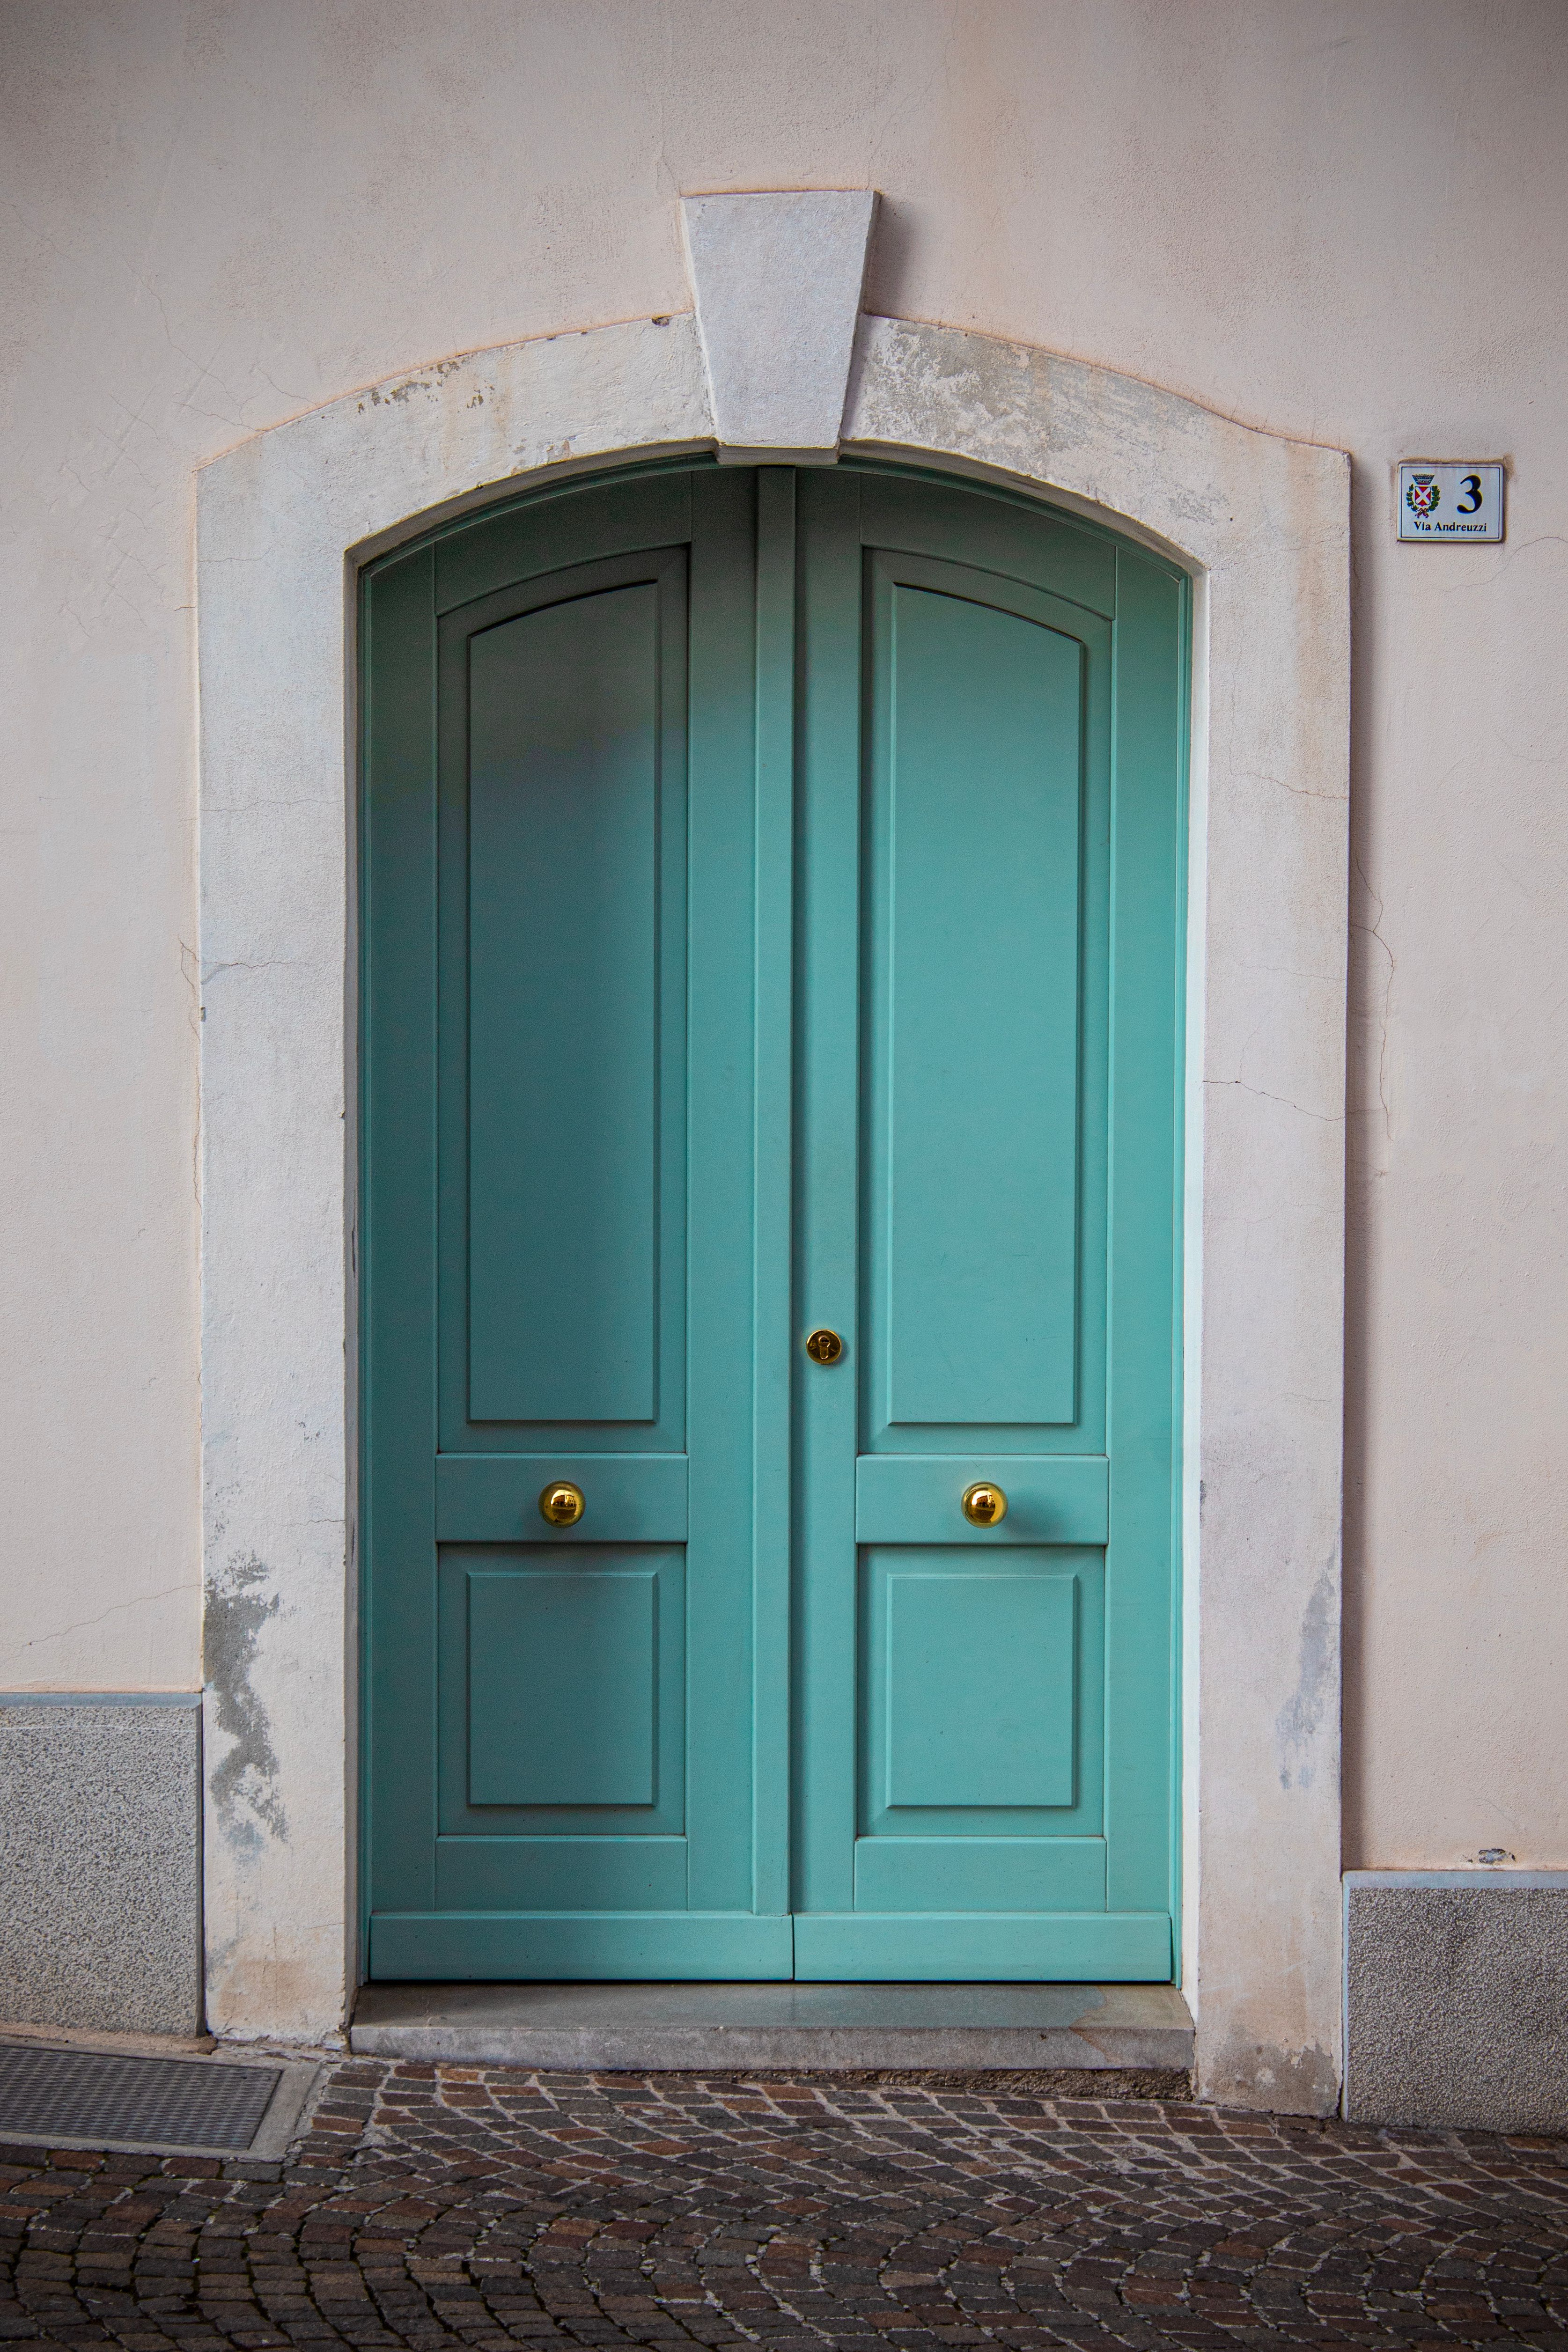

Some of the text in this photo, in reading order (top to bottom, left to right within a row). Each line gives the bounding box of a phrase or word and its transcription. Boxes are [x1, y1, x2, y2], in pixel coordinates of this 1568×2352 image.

[1457, 474, 1483, 514] 3
[1413, 521, 1487, 532] Via Andreuzzi
